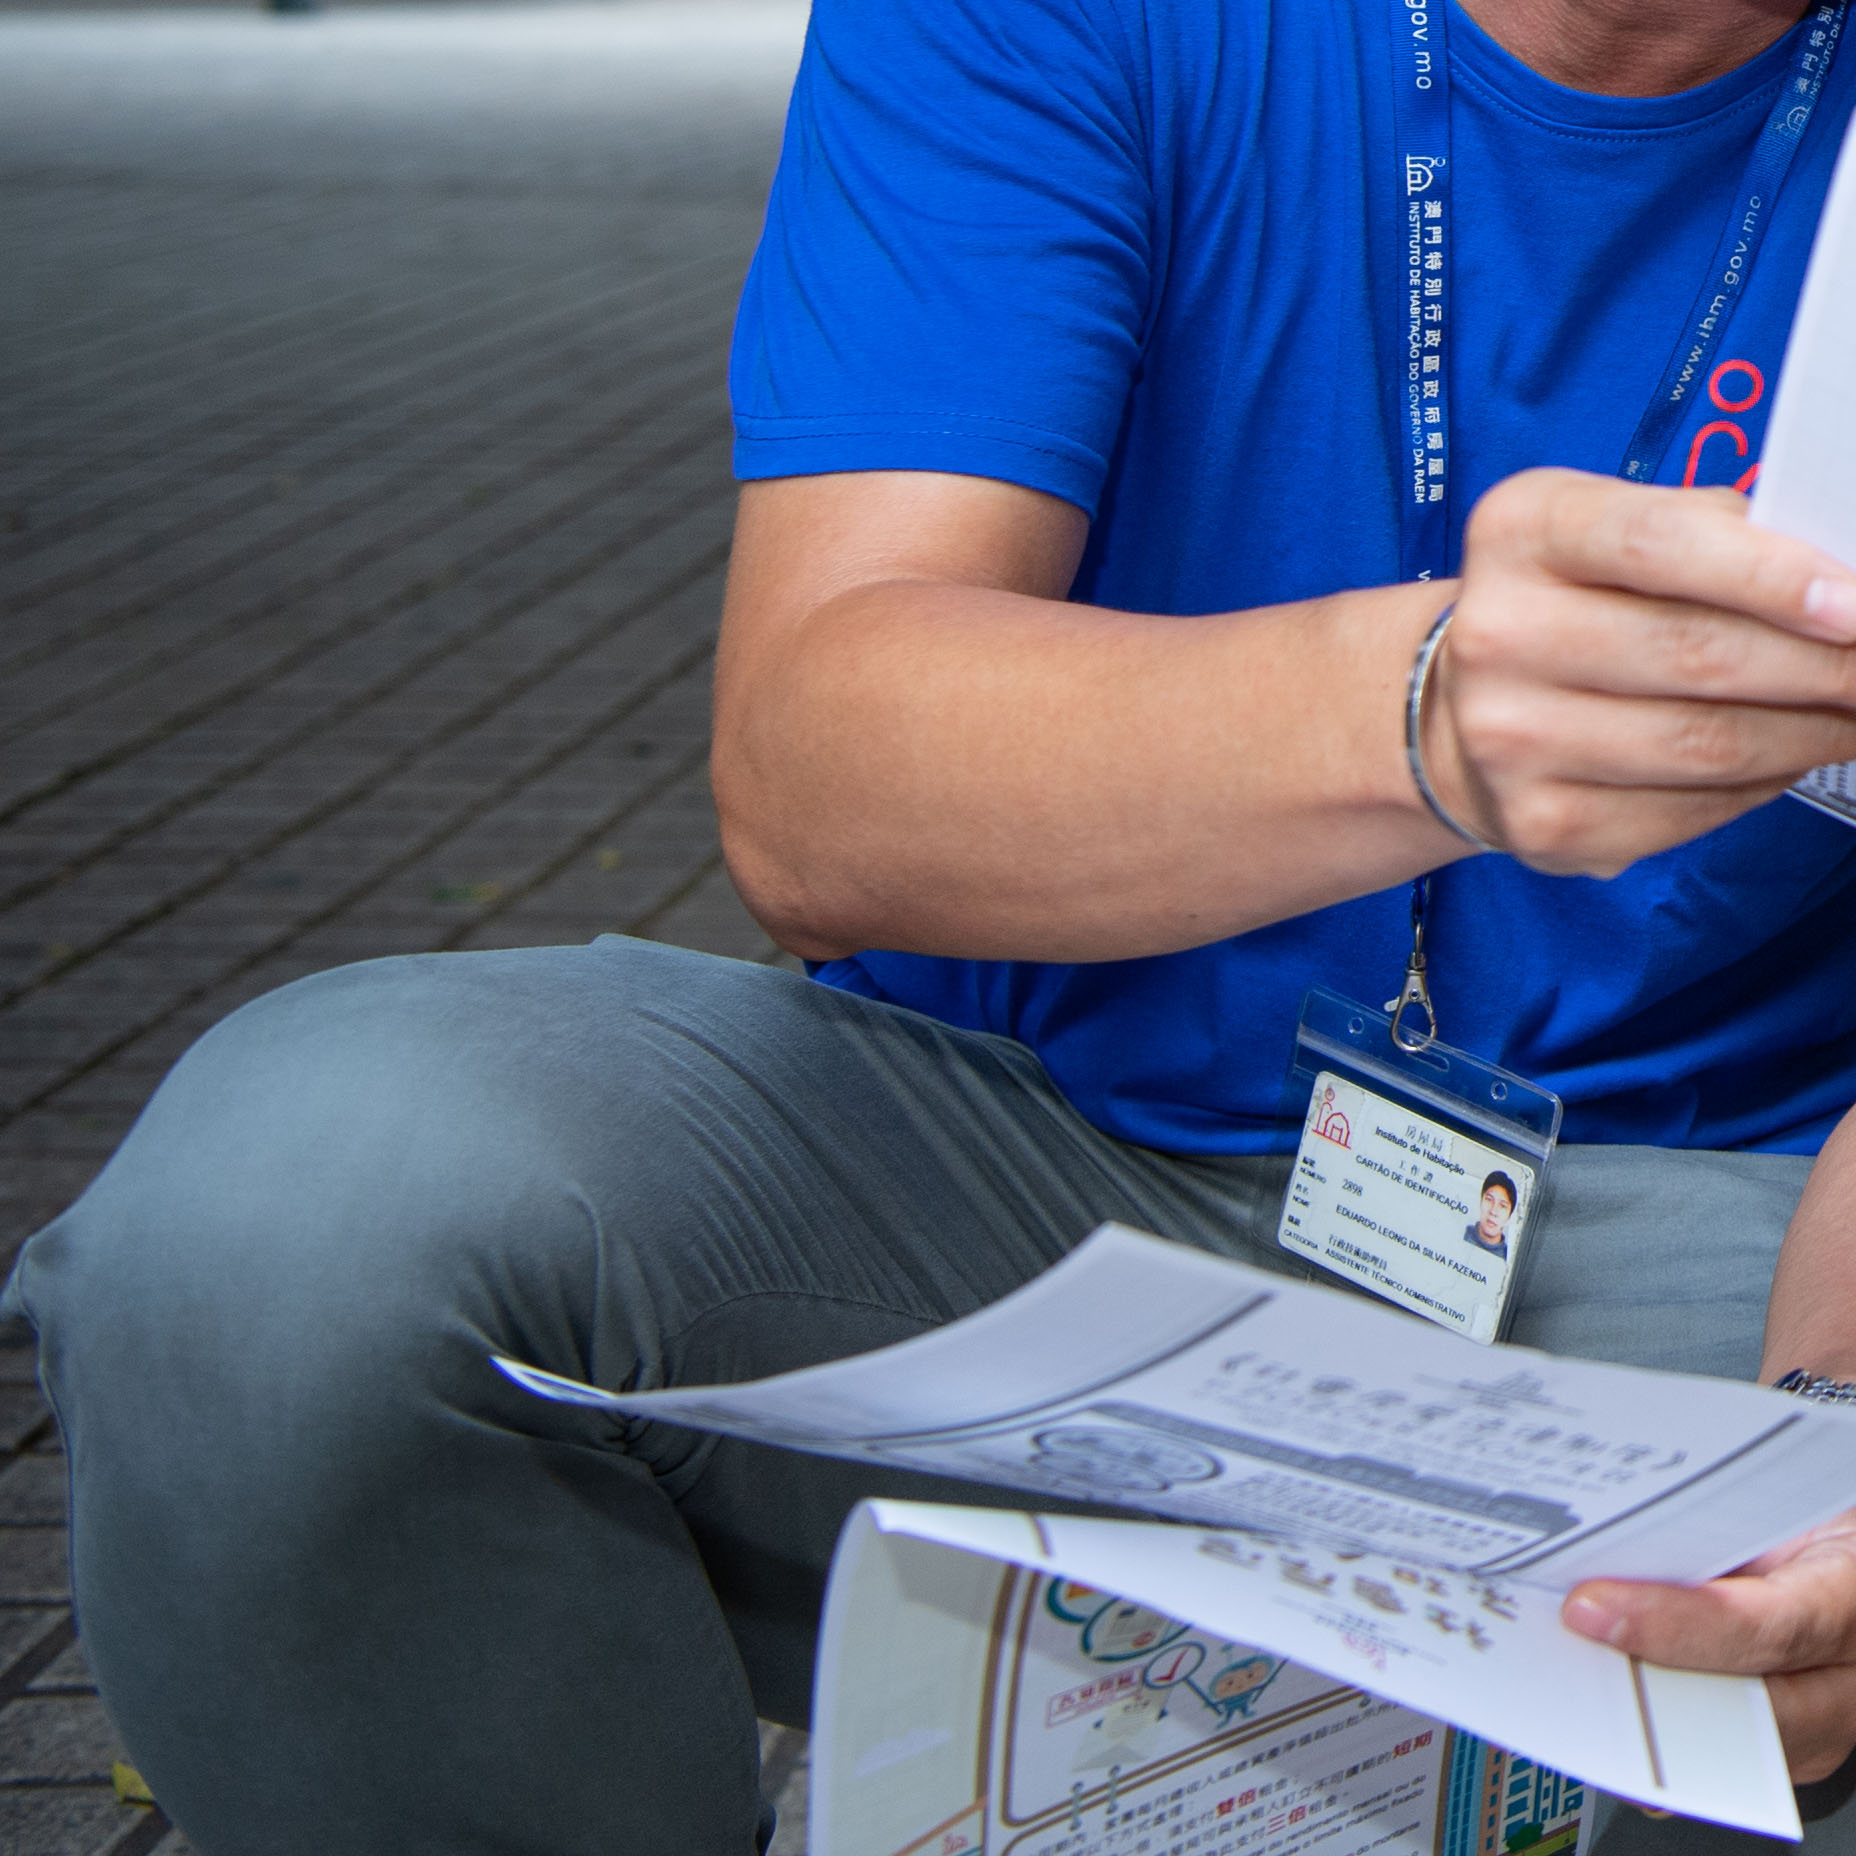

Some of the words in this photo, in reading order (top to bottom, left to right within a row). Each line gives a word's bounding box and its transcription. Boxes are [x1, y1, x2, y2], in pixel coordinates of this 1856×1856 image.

[1408, 201, 1422, 265] INSTITUTO
[1408, 270, 1422, 286] DE
[1670, 194, 1762, 402] www.ihm.gov.mo
[1407, 290, 1422, 359] HABITAÇÃO
[1422, 200, 1444, 502] 澳門特別行政區政府房屋局
[1408, 361, 1419, 381] DO
[1409, 383, 1423, 445] GOVERNO
[1412, 448, 1423, 466] DA
[1413, 469, 1425, 504] RAEM
[1375, 1126, 1408, 1149] Instituto
[1409, 1144, 1421, 1154] de
[1422, 1148, 1465, 1176] Habitação
[1342, 1178, 1363, 1197] 2898
[1355, 1154, 1390, 1177] CARTÃO
[1391, 1171, 1403, 1184] DE
[1404, 1177, 1469, 1215] IDENTIFICAÇÃO
[1335, 1203, 1378, 1231] EDUARDO
[1377, 1225, 1408, 1246] LEONG
[1408, 1240, 1421, 1253] DA
[1422, 1247, 1446, 1265] SILVA
[1447, 1258, 1488, 1285] FAZENDA
[1325, 1248, 1370, 1275] ASSISTENTE
[1371, 1269, 1404, 1292] TÉCNICO
[1403, 1287, 1466, 1323] ADMINISTRATIVO
[1352, 1787, 1393, 1812] mensal
